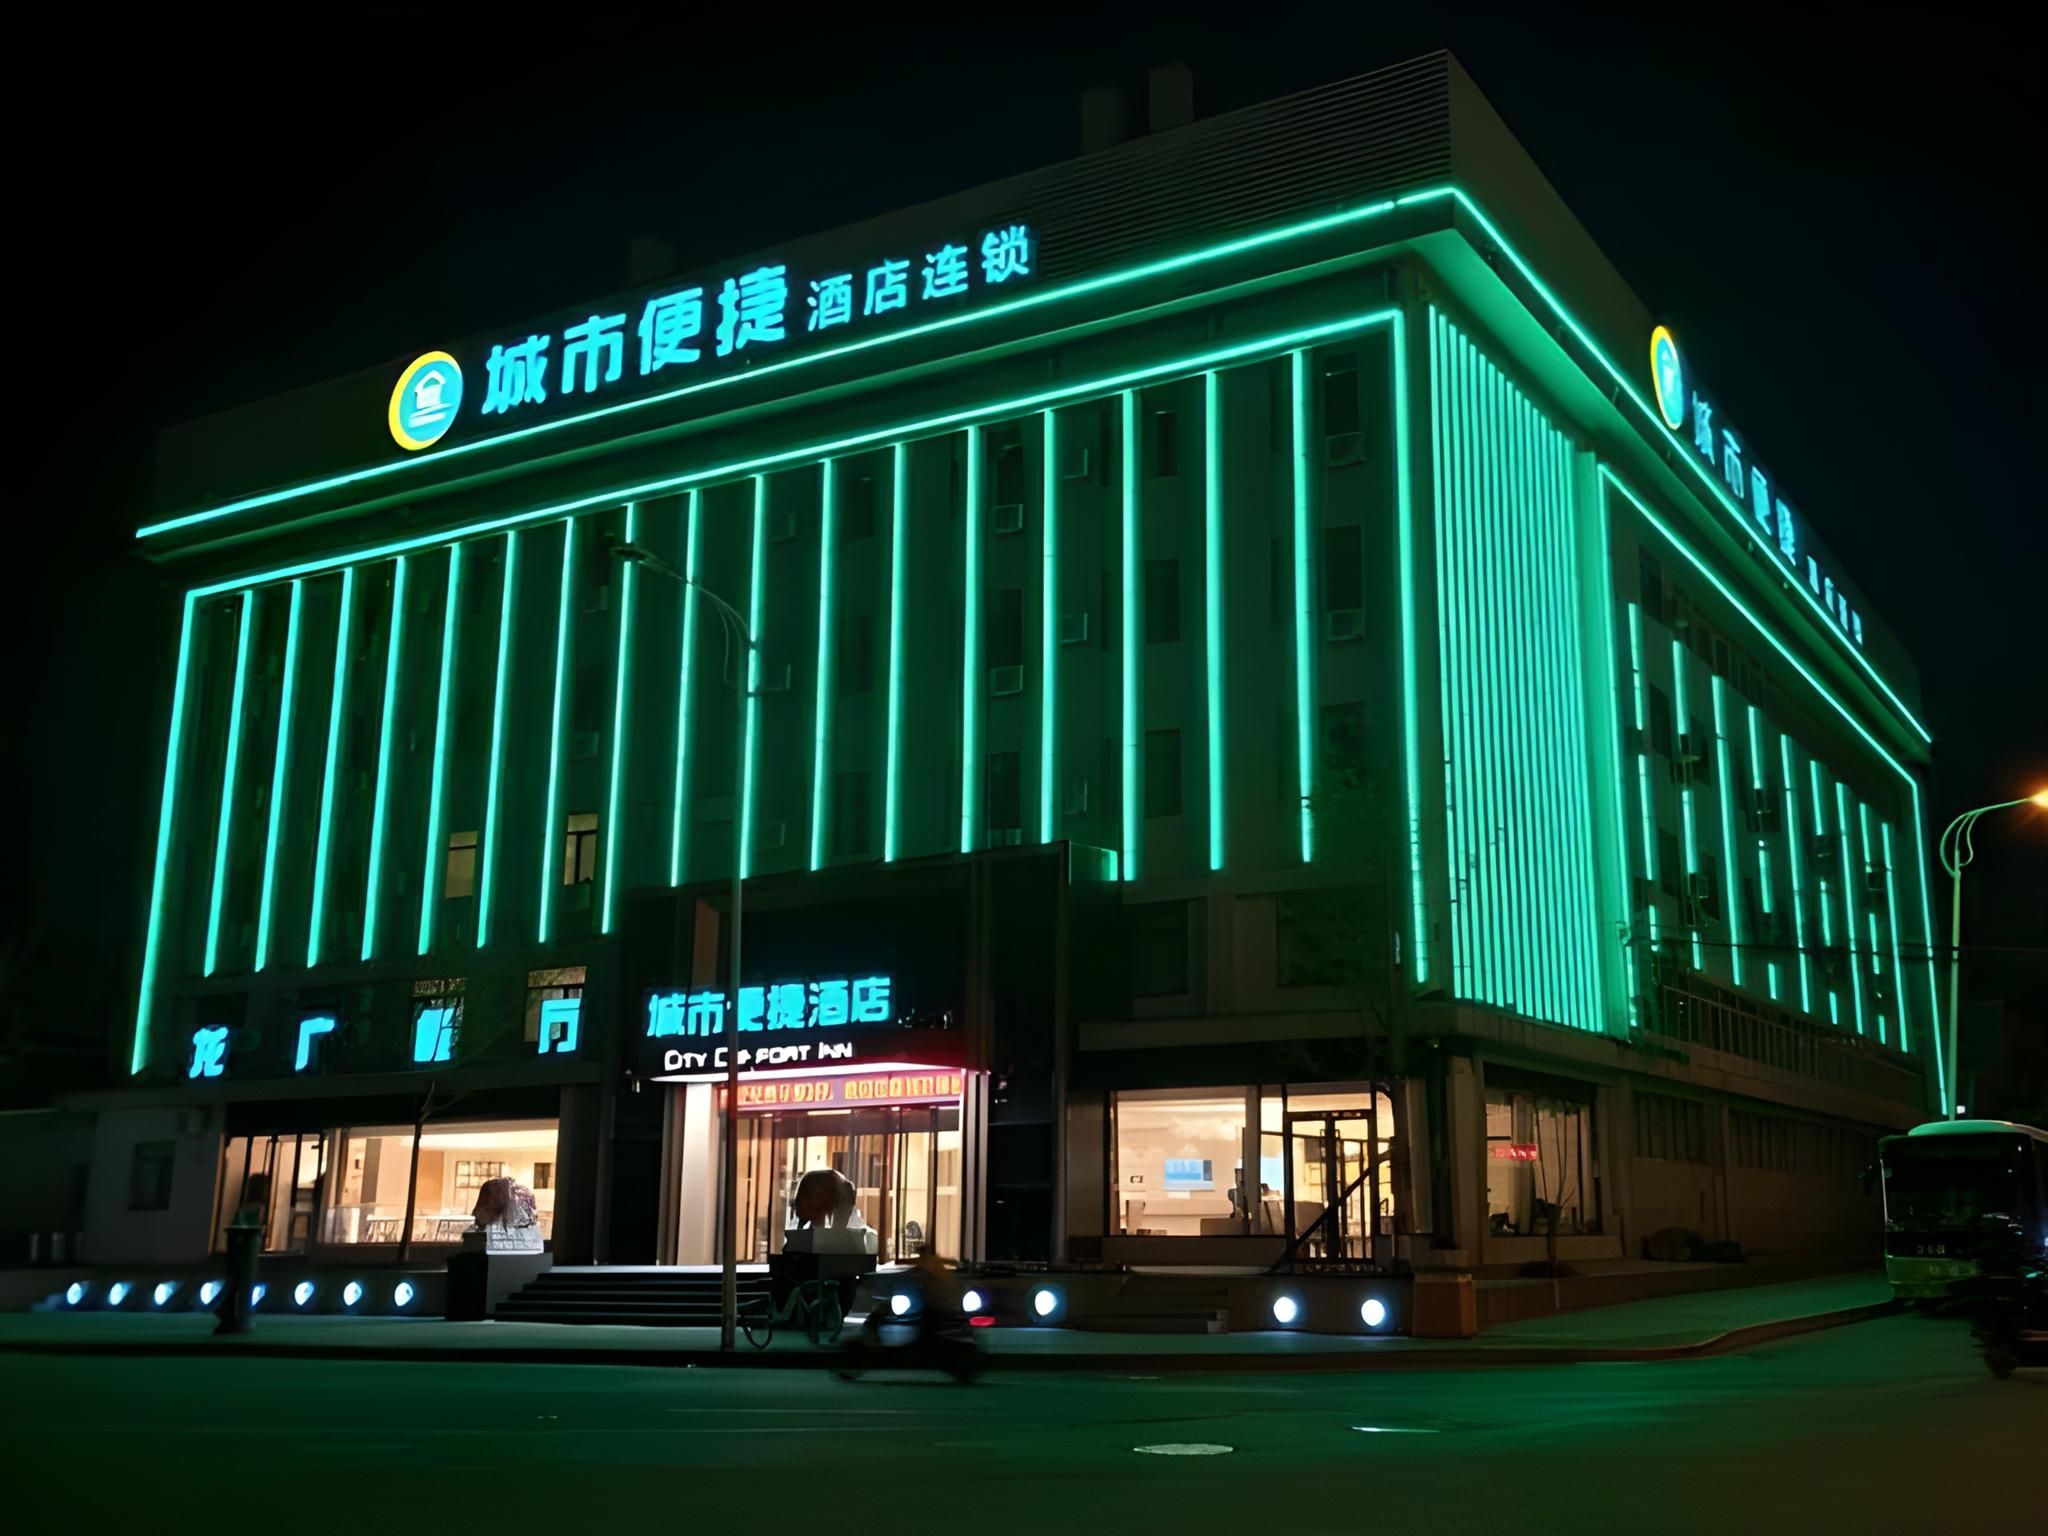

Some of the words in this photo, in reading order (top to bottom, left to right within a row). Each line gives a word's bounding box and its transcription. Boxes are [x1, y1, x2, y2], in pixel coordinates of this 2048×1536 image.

[481, 264, 789, 416] 城市便捷
[807, 225, 1030, 332] 酒店连锁
[646, 976, 891, 1038] 城市便捷酒店
